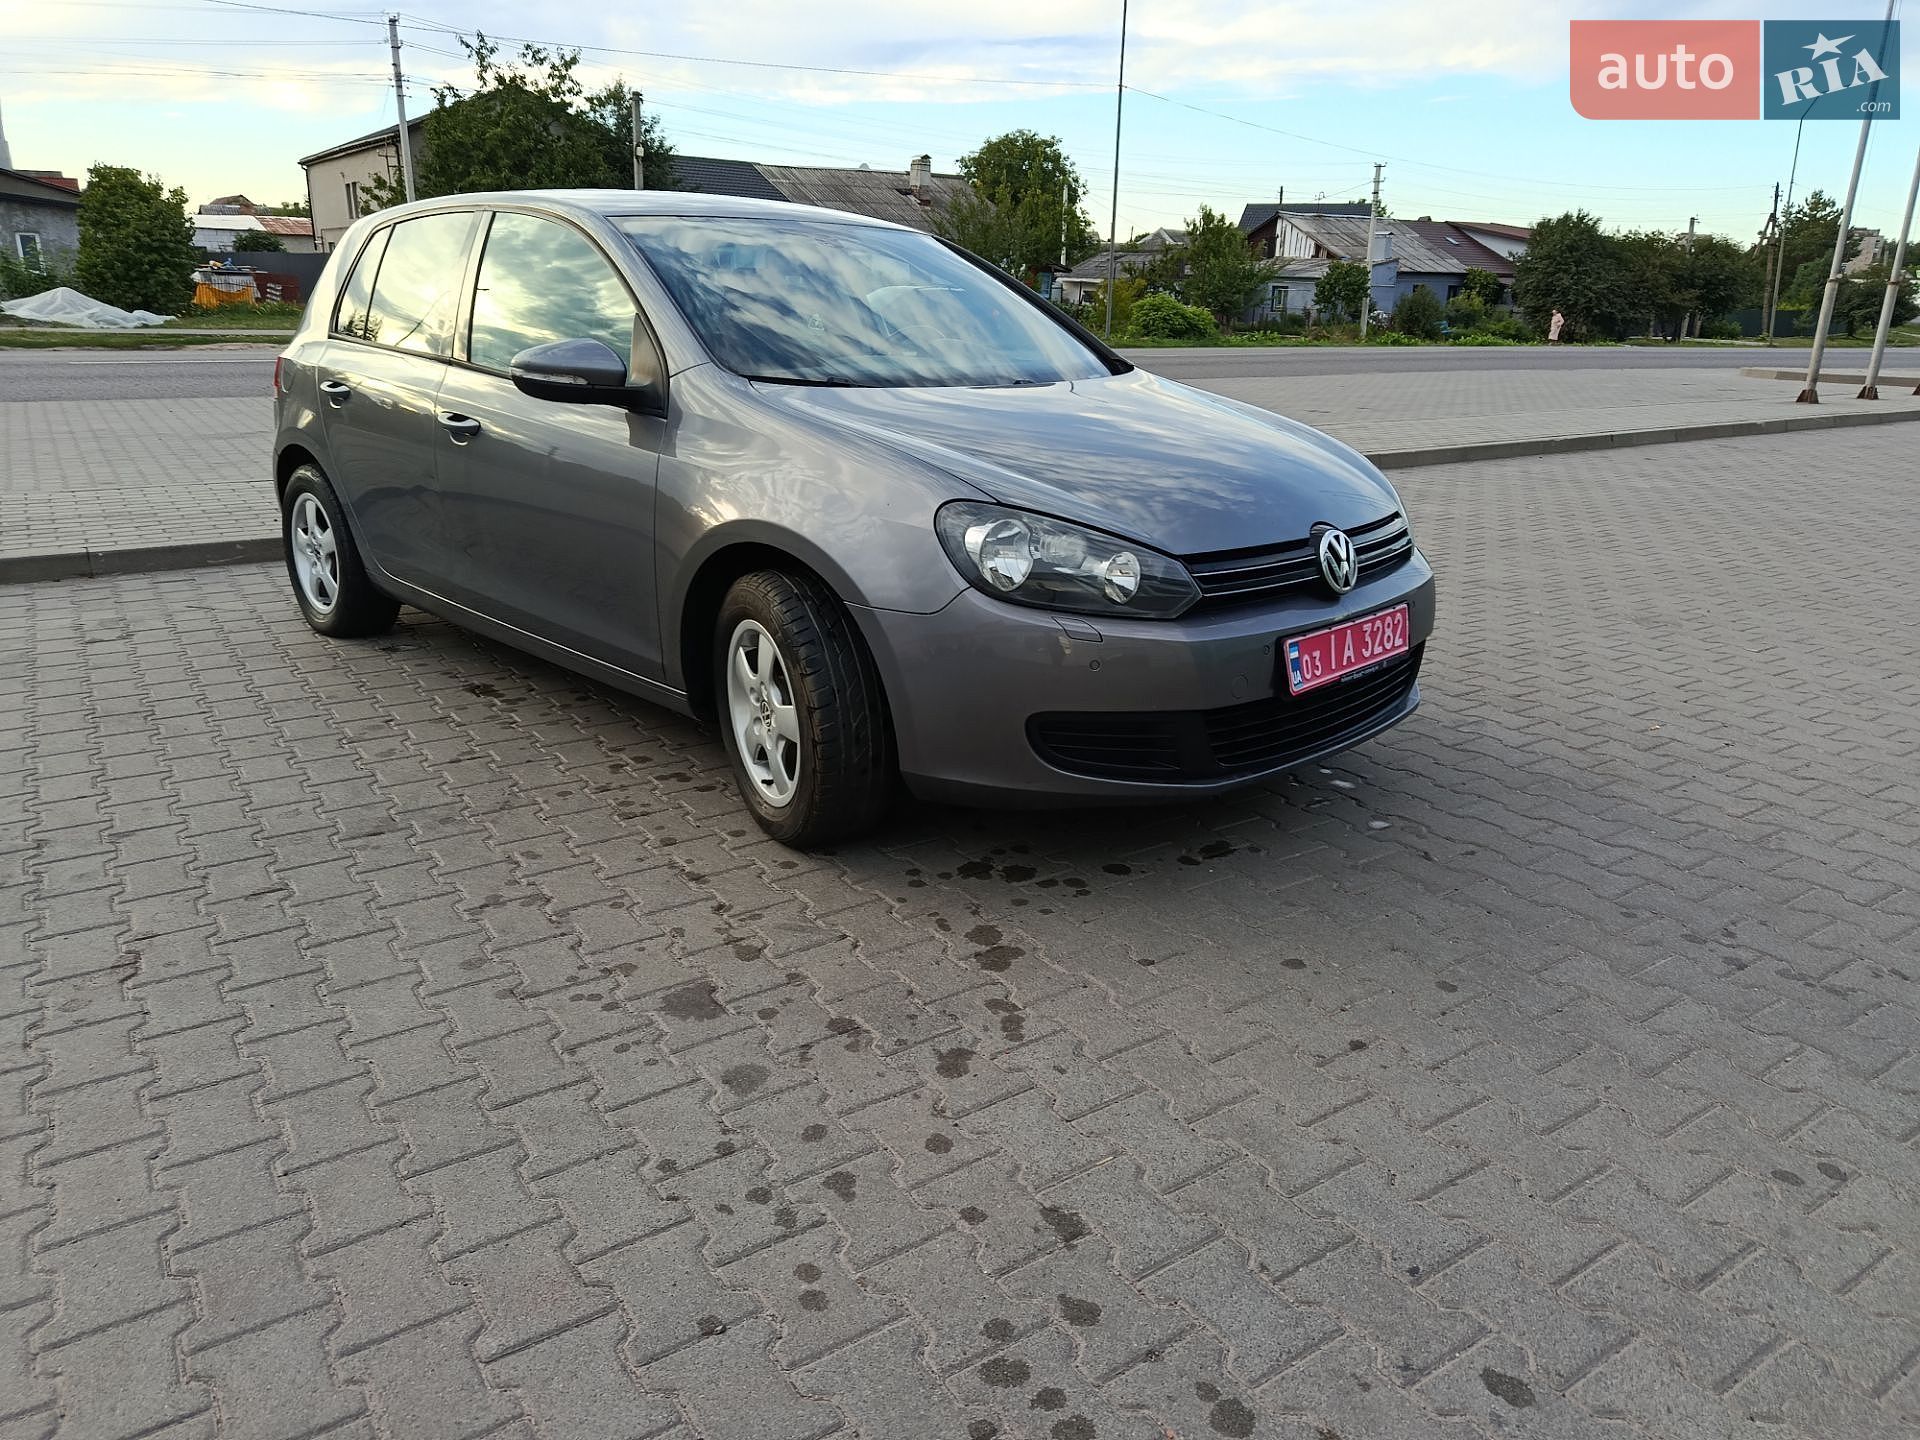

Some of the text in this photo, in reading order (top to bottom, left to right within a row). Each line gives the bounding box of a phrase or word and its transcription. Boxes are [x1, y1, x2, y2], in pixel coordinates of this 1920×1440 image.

[1303, 650, 1322, 679] 03
[1331, 630, 1355, 669] IA
[1362, 613, 1403, 657] 3282
